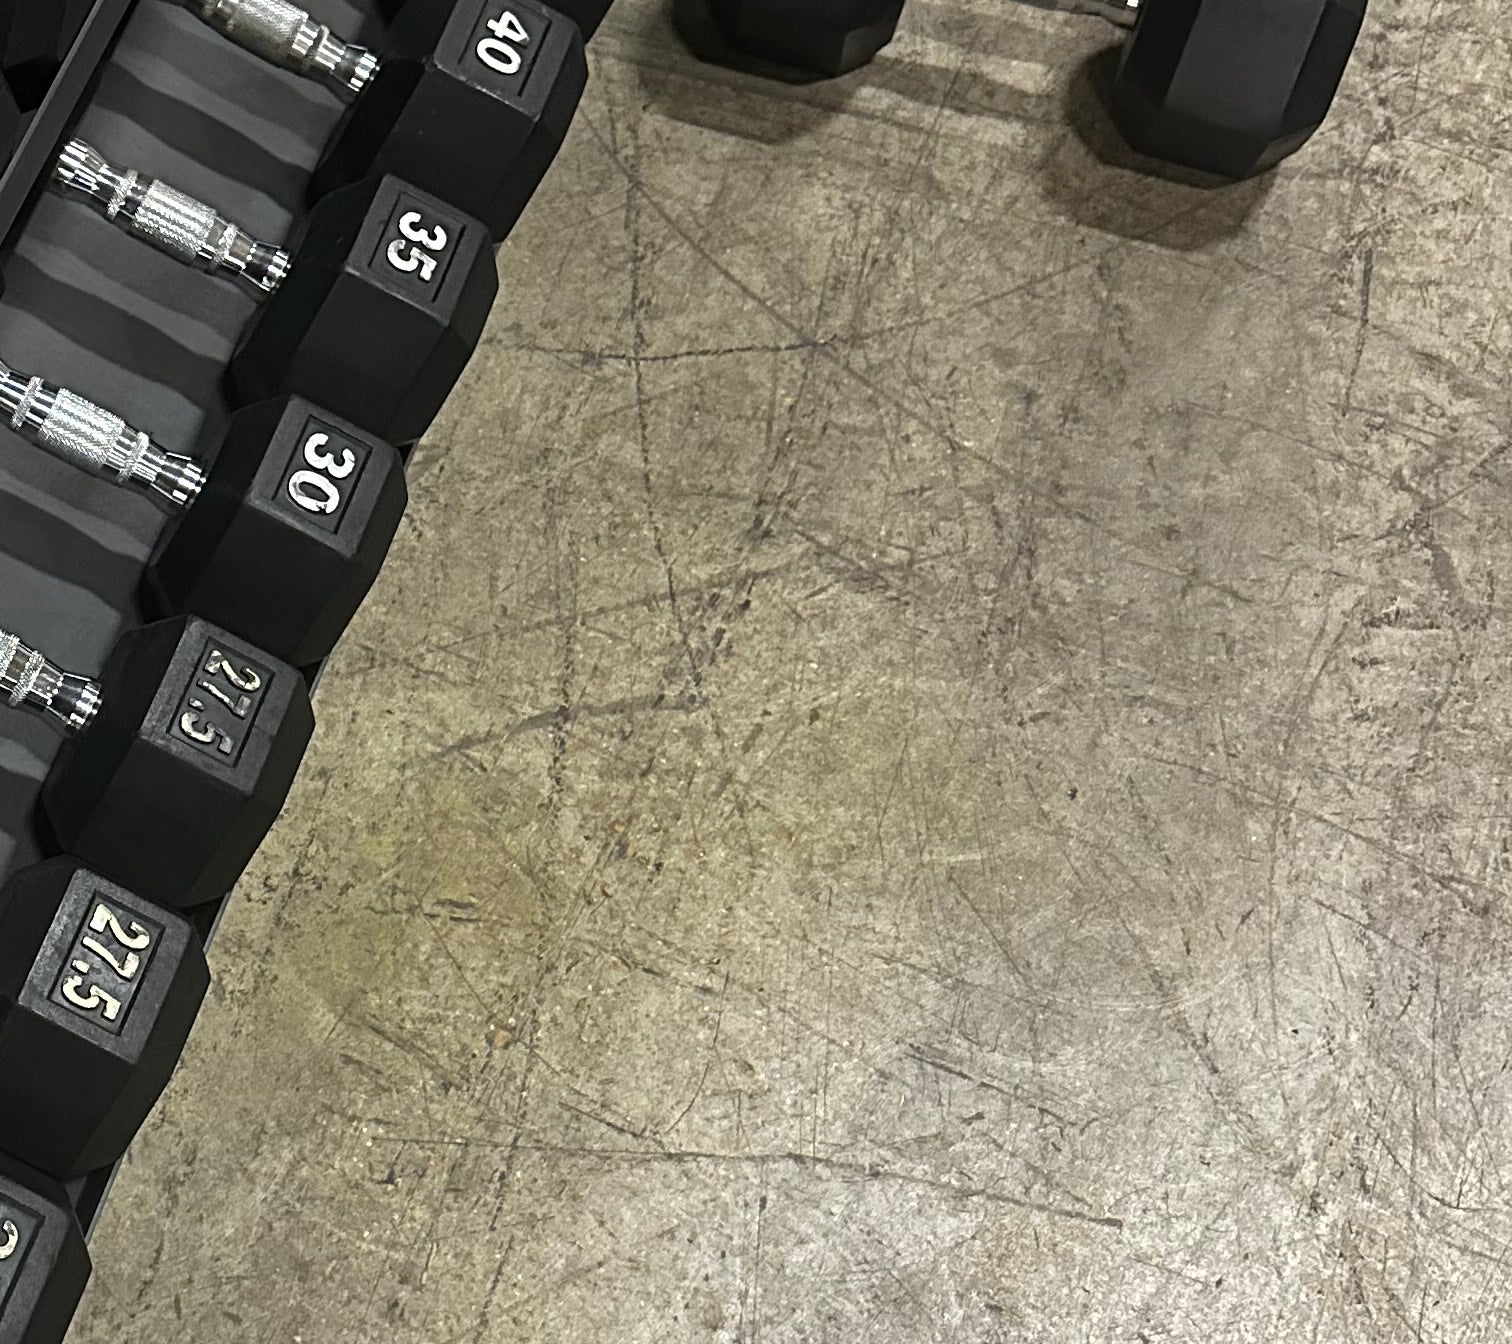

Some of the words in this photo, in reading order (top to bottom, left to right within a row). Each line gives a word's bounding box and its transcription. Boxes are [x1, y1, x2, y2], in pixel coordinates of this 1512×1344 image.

[477, 12, 529, 73] 40
[388, 212, 446, 280] 35
[289, 434, 355, 513] 30
[179, 650, 262, 755] 27.5
[62, 903, 150, 1021] 27.5
